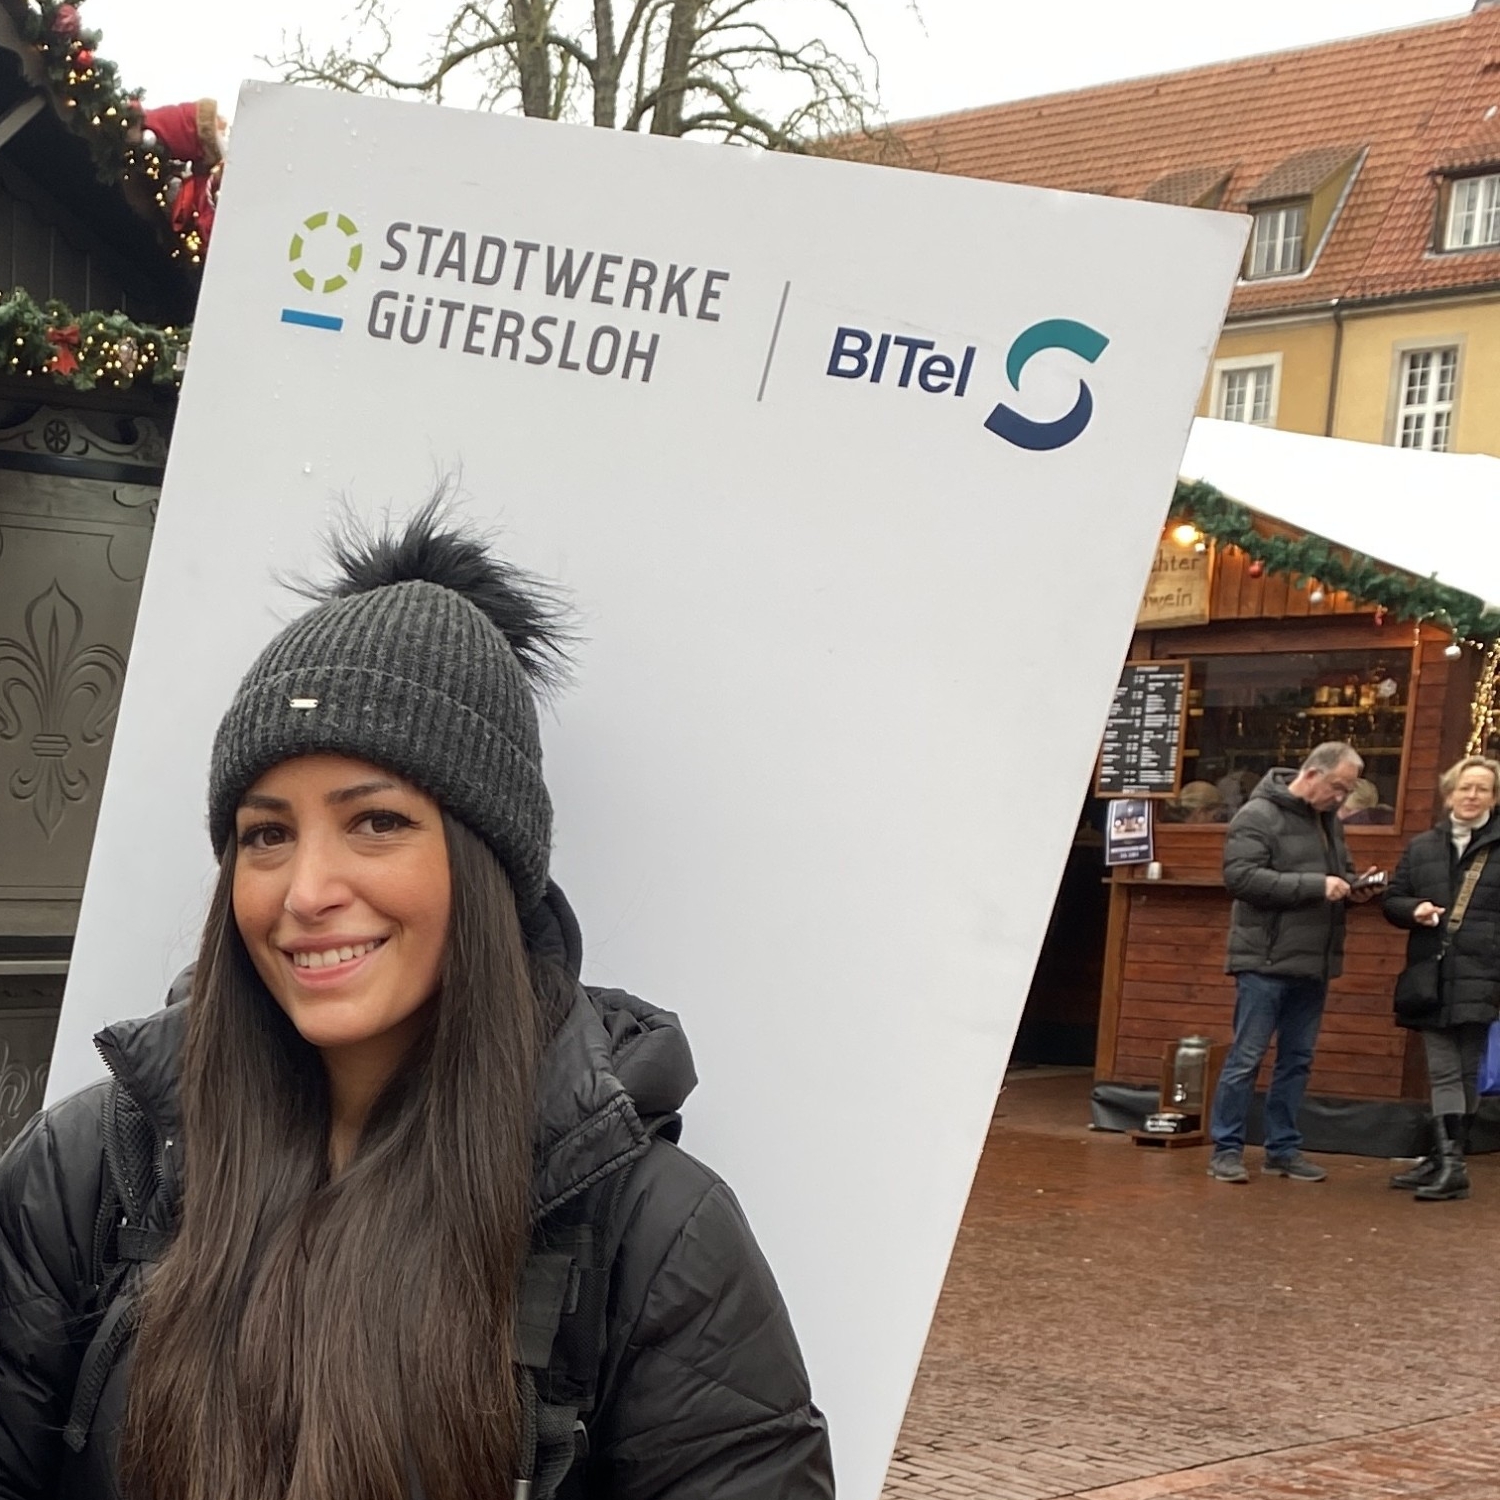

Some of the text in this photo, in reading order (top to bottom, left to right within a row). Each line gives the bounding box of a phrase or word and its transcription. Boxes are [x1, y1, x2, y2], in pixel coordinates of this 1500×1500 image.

[366, 290, 661, 384] GÜTERSLOH
[380, 221, 976, 398] STADTWERKE BITel
